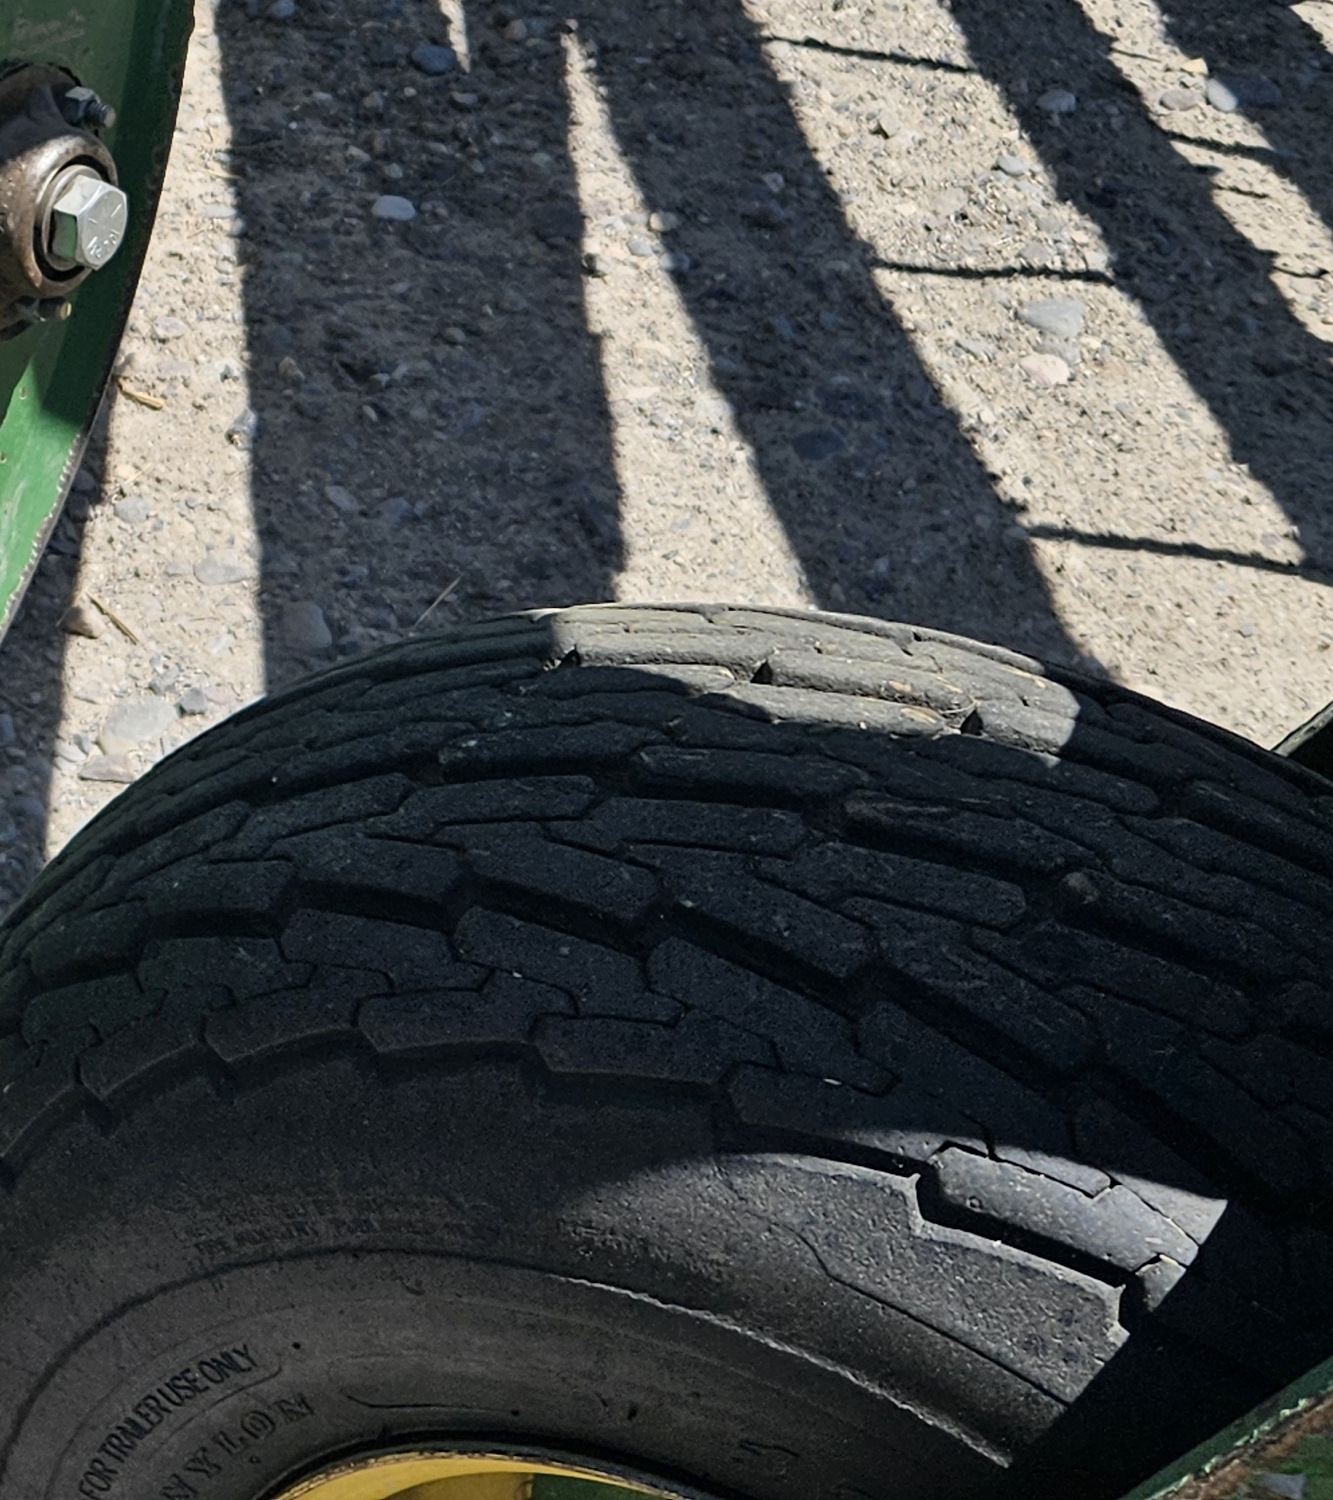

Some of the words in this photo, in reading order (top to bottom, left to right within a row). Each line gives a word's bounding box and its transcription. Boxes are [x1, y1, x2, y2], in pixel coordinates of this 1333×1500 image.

[197, 1343, 259, 1384] ONLY
[156, 1367, 211, 1407] USE
[97, 1394, 172, 1463] TRAILER
[79, 1457, 118, 1500] FOR
